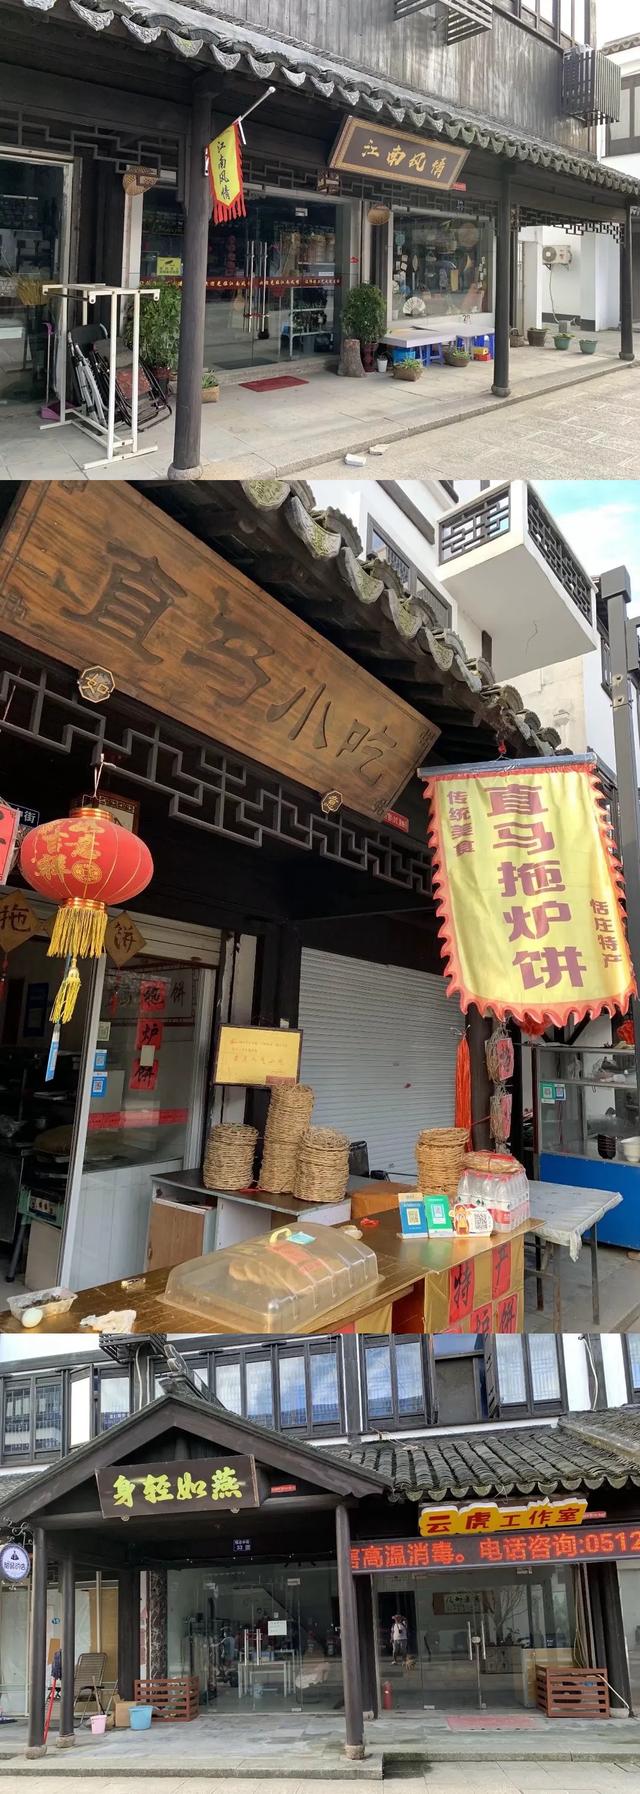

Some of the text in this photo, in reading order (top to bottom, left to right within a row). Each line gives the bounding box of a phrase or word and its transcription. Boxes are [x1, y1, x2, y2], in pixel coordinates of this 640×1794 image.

[217, 141, 231, 200] 江南风情
[361, 139, 447, 179] 江南风情
[58, 537, 398, 786] 直马小吃
[447, 790, 475, 857] 传统美食
[484, 783, 588, 990] 直马拖炉饼
[426, 1507, 581, 1534] 云虎工作室
